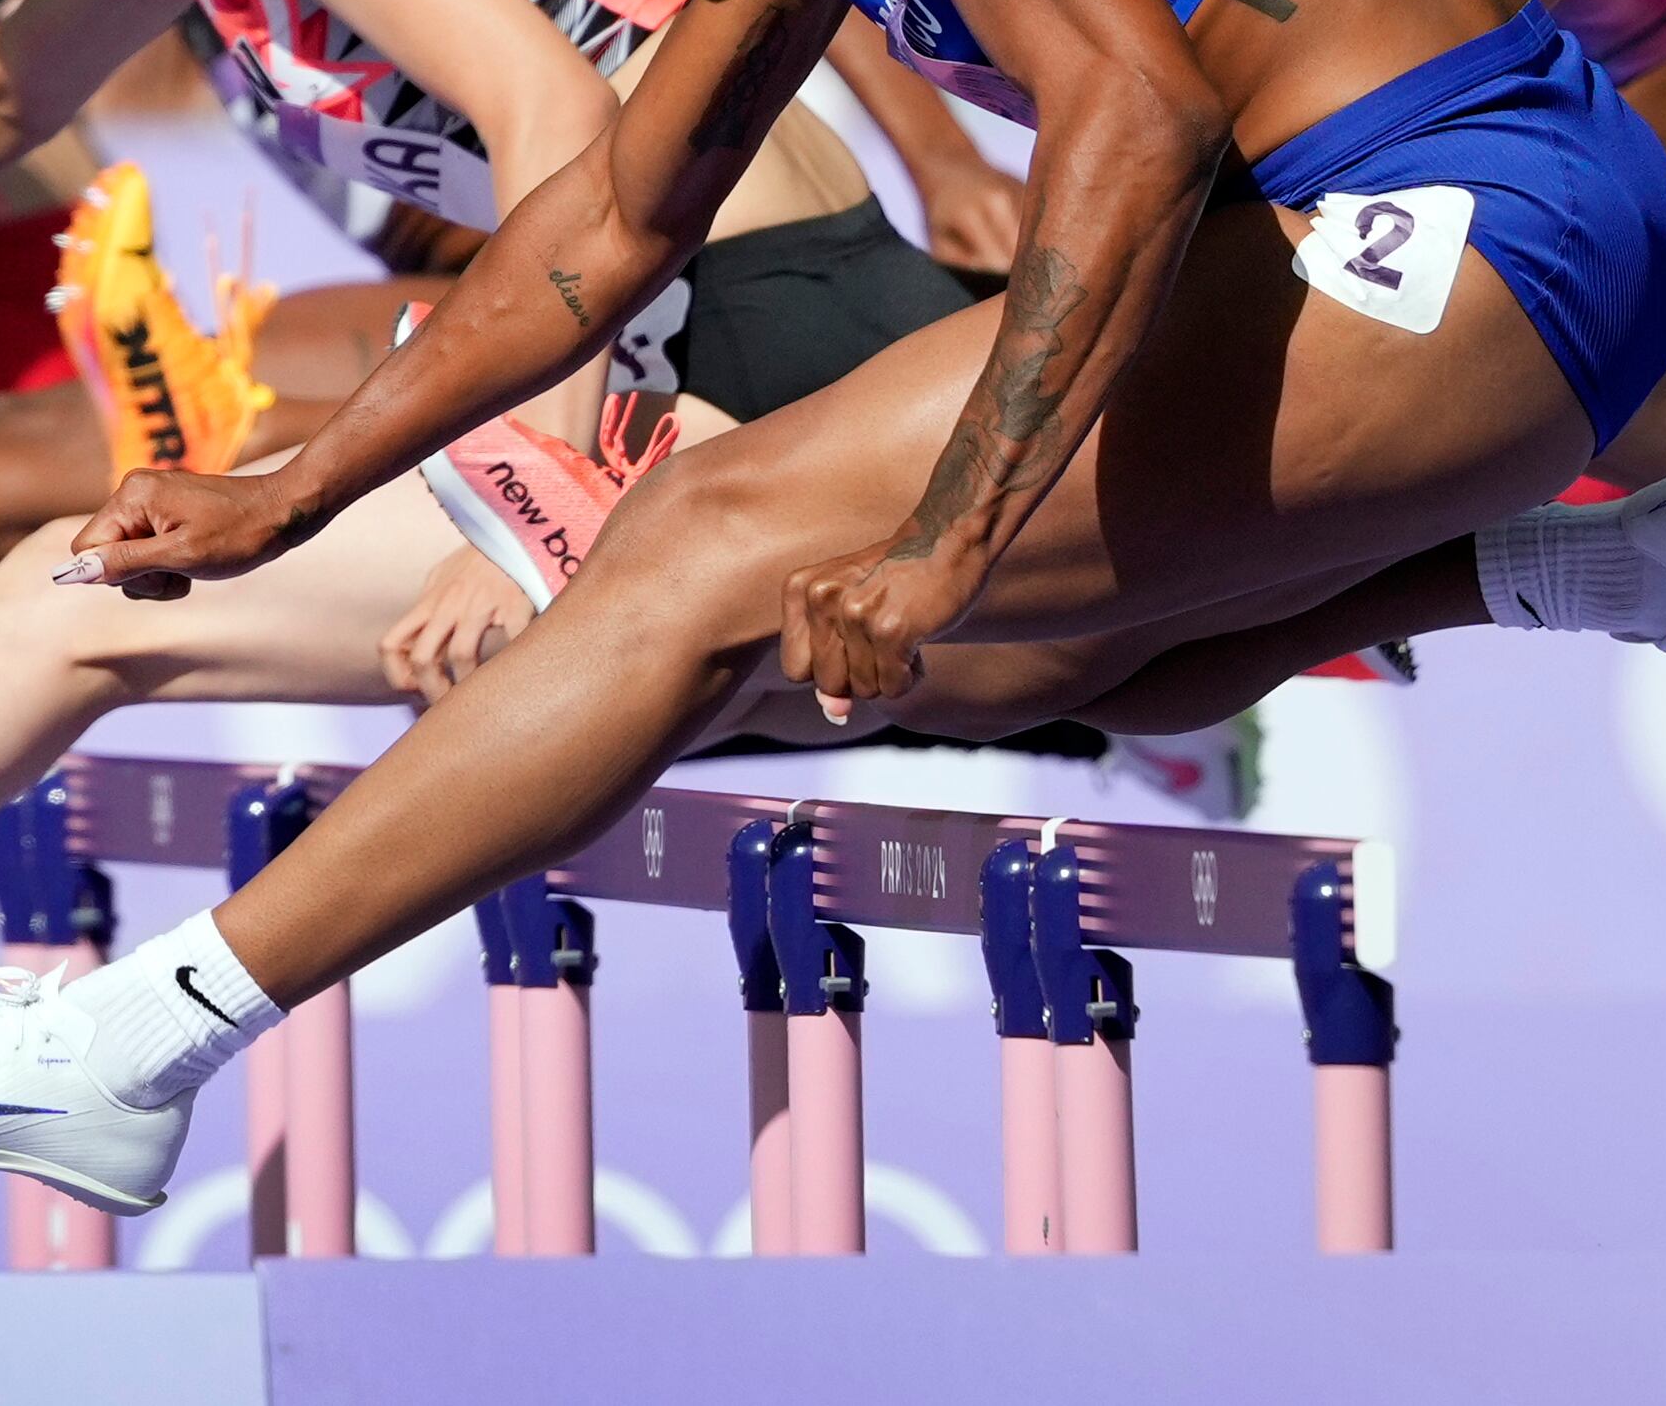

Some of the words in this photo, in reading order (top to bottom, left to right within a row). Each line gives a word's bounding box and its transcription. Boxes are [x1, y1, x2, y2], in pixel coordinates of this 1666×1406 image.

[1344, 201, 1415, 291] 2
[486, 461, 550, 525] new
[880, 840, 913, 896] PARIS
[915, 844, 946, 899] 2024
